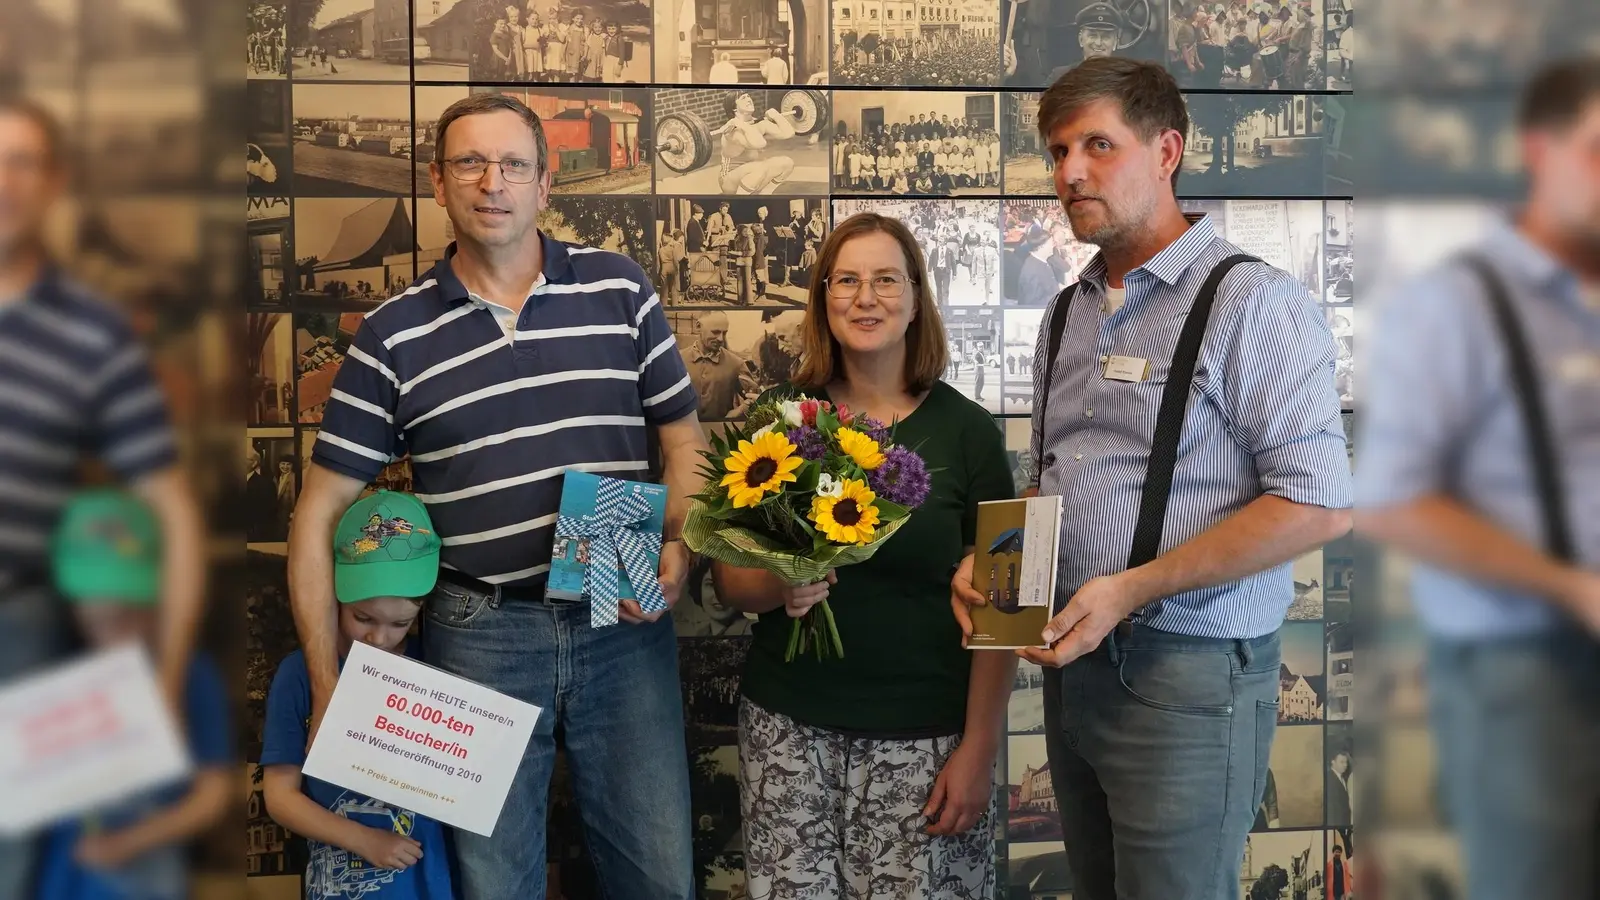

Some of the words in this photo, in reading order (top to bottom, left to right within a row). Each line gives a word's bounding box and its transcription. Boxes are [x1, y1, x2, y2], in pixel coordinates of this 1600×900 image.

[362, 664, 380, 678] Wir
[382, 673, 428, 696] erwarten
[430, 690, 468, 710] HEUTE
[469, 706, 515, 727] unsere/n
[386, 693, 475, 736] 60.000-ten
[346, 729, 367, 743] seit
[368, 735, 455, 775] Wiedereröffnung
[457, 767, 483, 784] 2010
[374, 715, 468, 760] Besucher/in
[367, 768, 388, 782] Preis
[389, 777, 399, 786] zu
[400, 781, 438, 800] gewinnen
